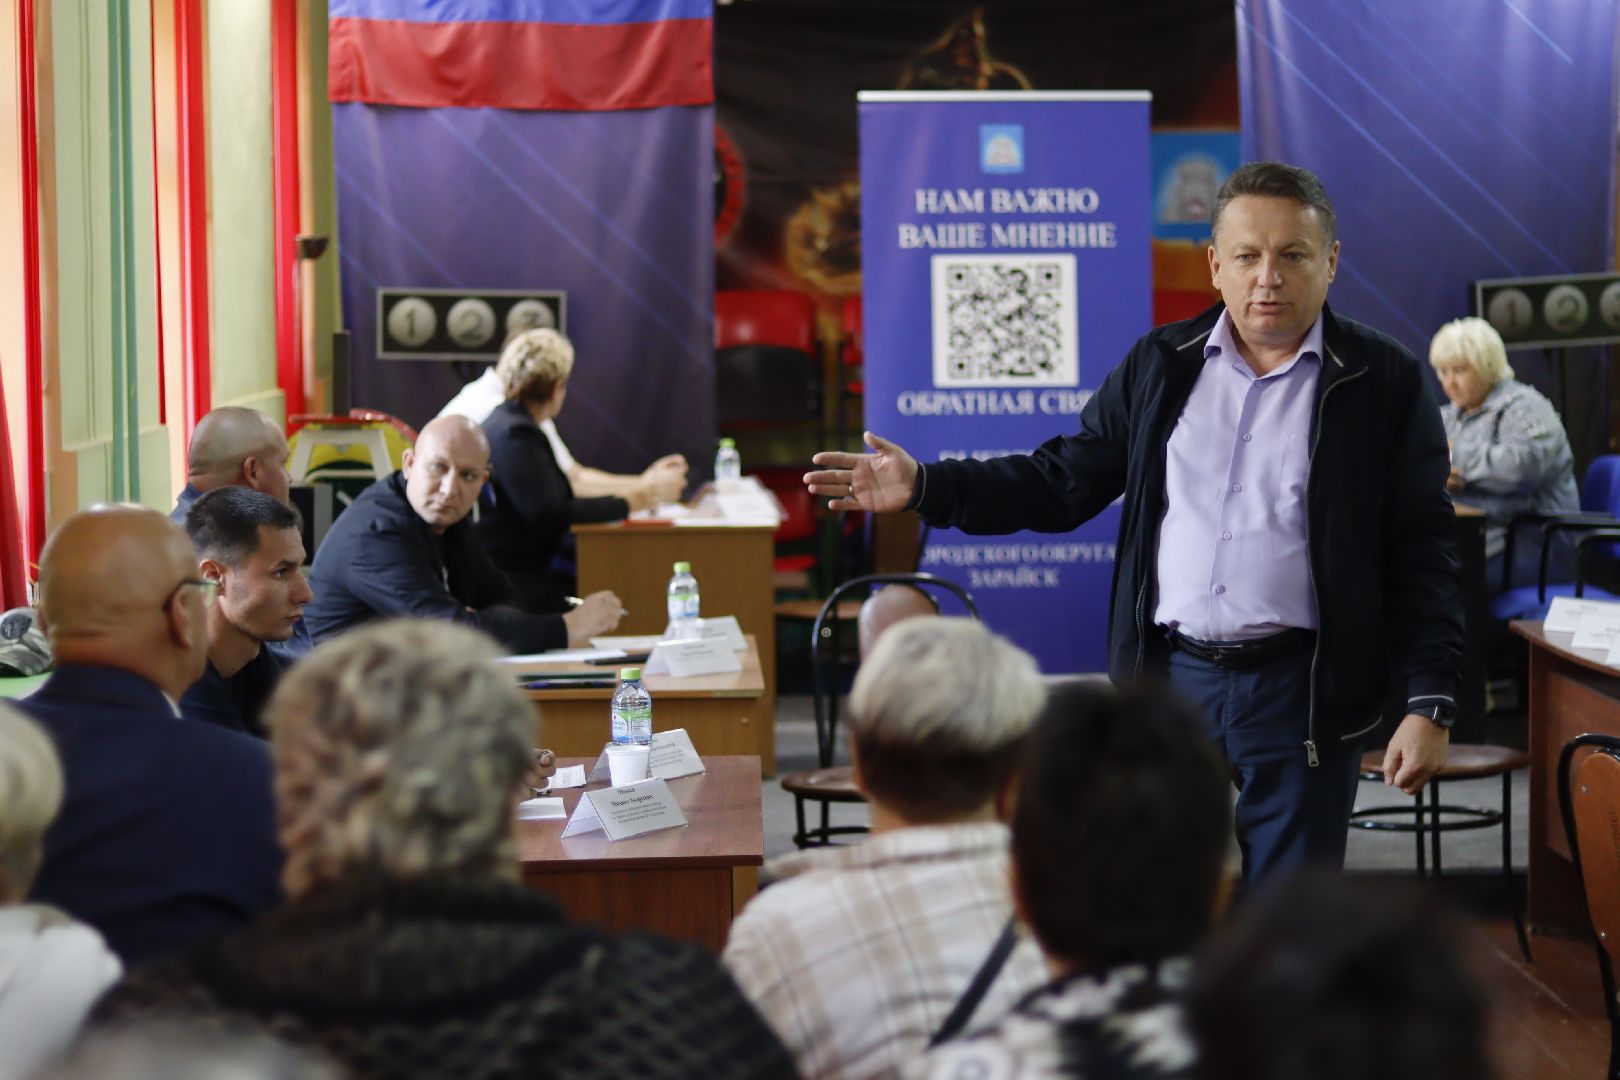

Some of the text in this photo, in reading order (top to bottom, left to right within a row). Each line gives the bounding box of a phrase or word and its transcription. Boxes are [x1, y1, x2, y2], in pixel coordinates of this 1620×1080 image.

[916, 187, 1099, 214] НАМ ВАЖНО
[899, 222, 1117, 248] ВАШЕ МНЕНИЕ
[460, 309, 485, 340] 2
[897, 389, 1094, 415] ОБРАТНАЯ СВЯ
[922, 543, 1040, 566] ОРОДСКОГО
